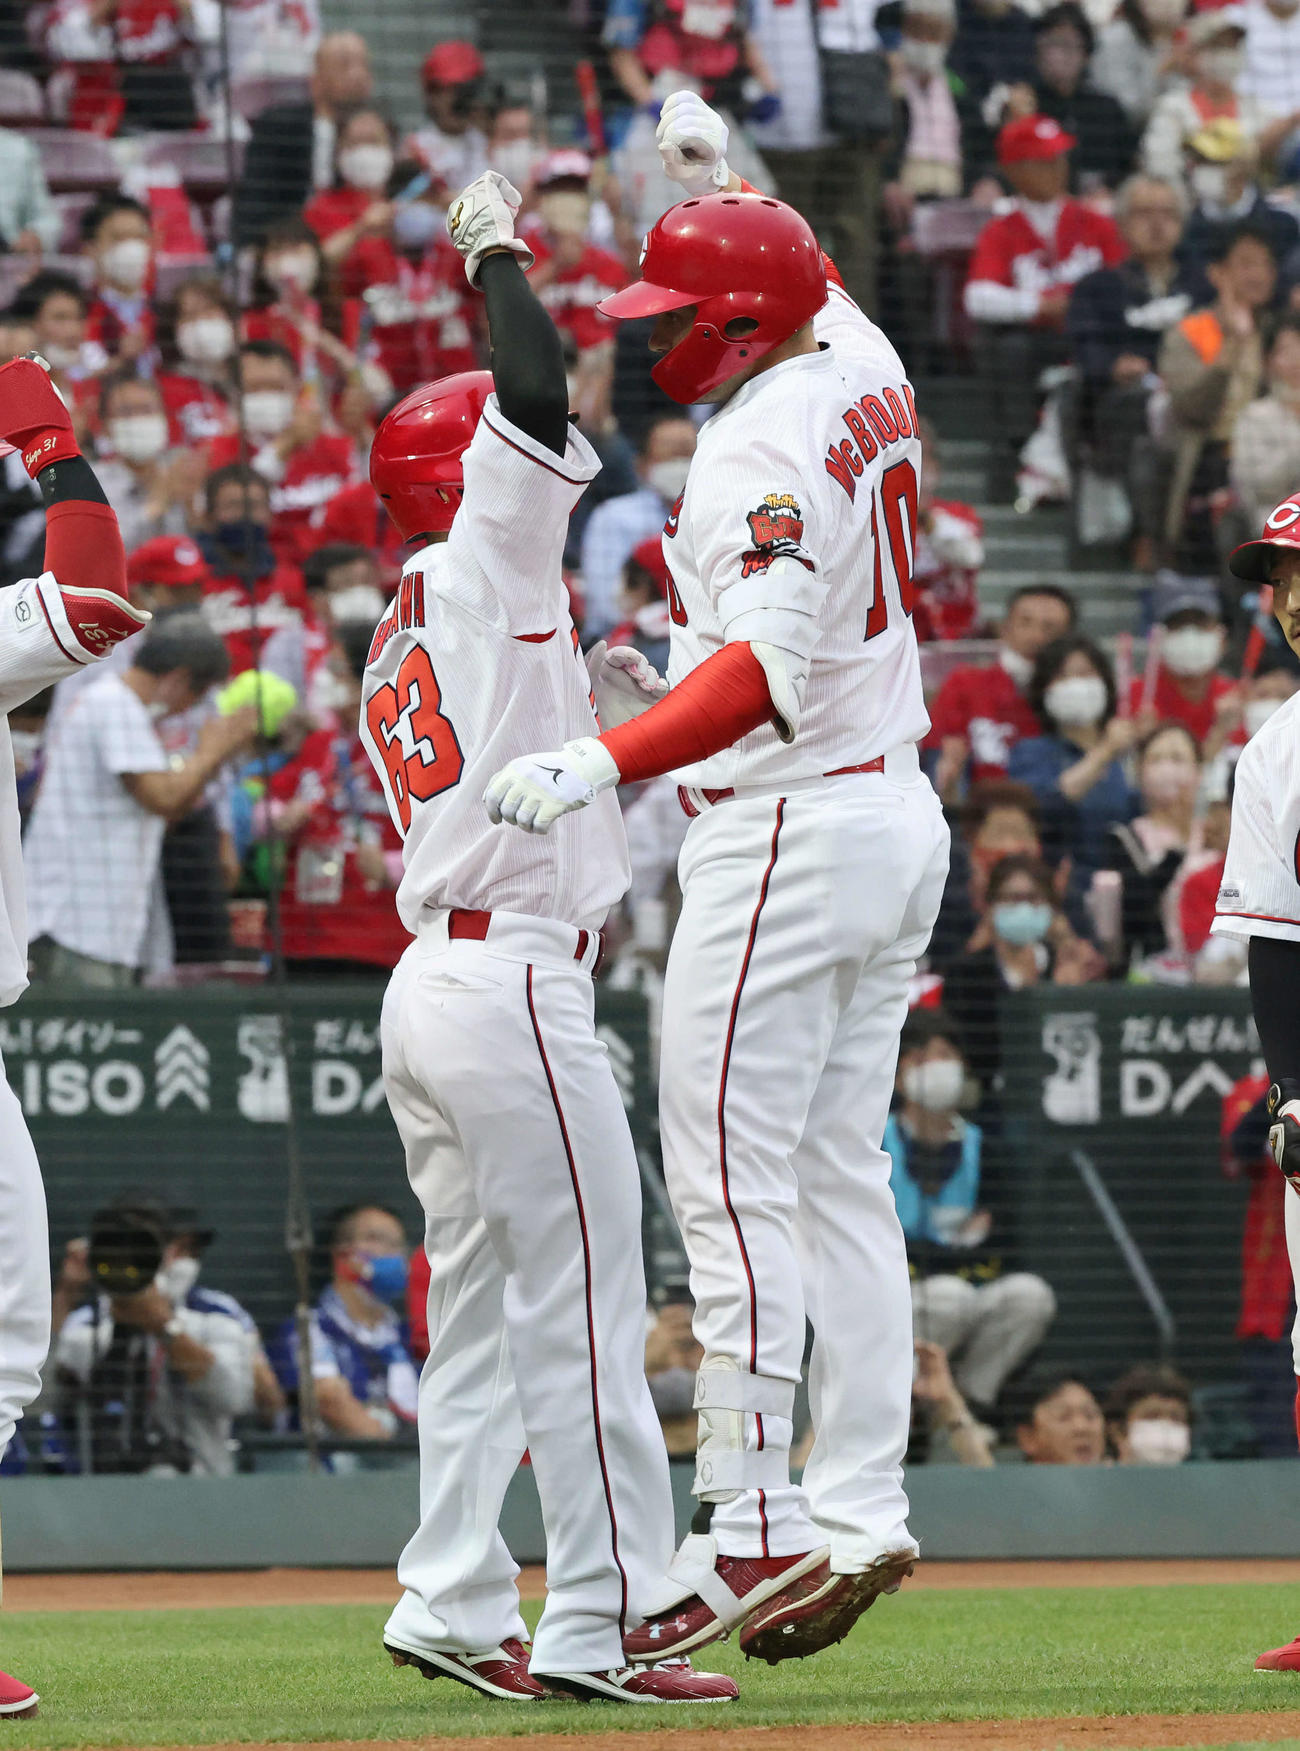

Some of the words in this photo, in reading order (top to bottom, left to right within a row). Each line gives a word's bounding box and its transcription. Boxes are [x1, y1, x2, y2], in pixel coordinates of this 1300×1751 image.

[43, 436, 57, 451] 31
[863, 456, 918, 643] 10
[366, 642, 465, 836] 63
